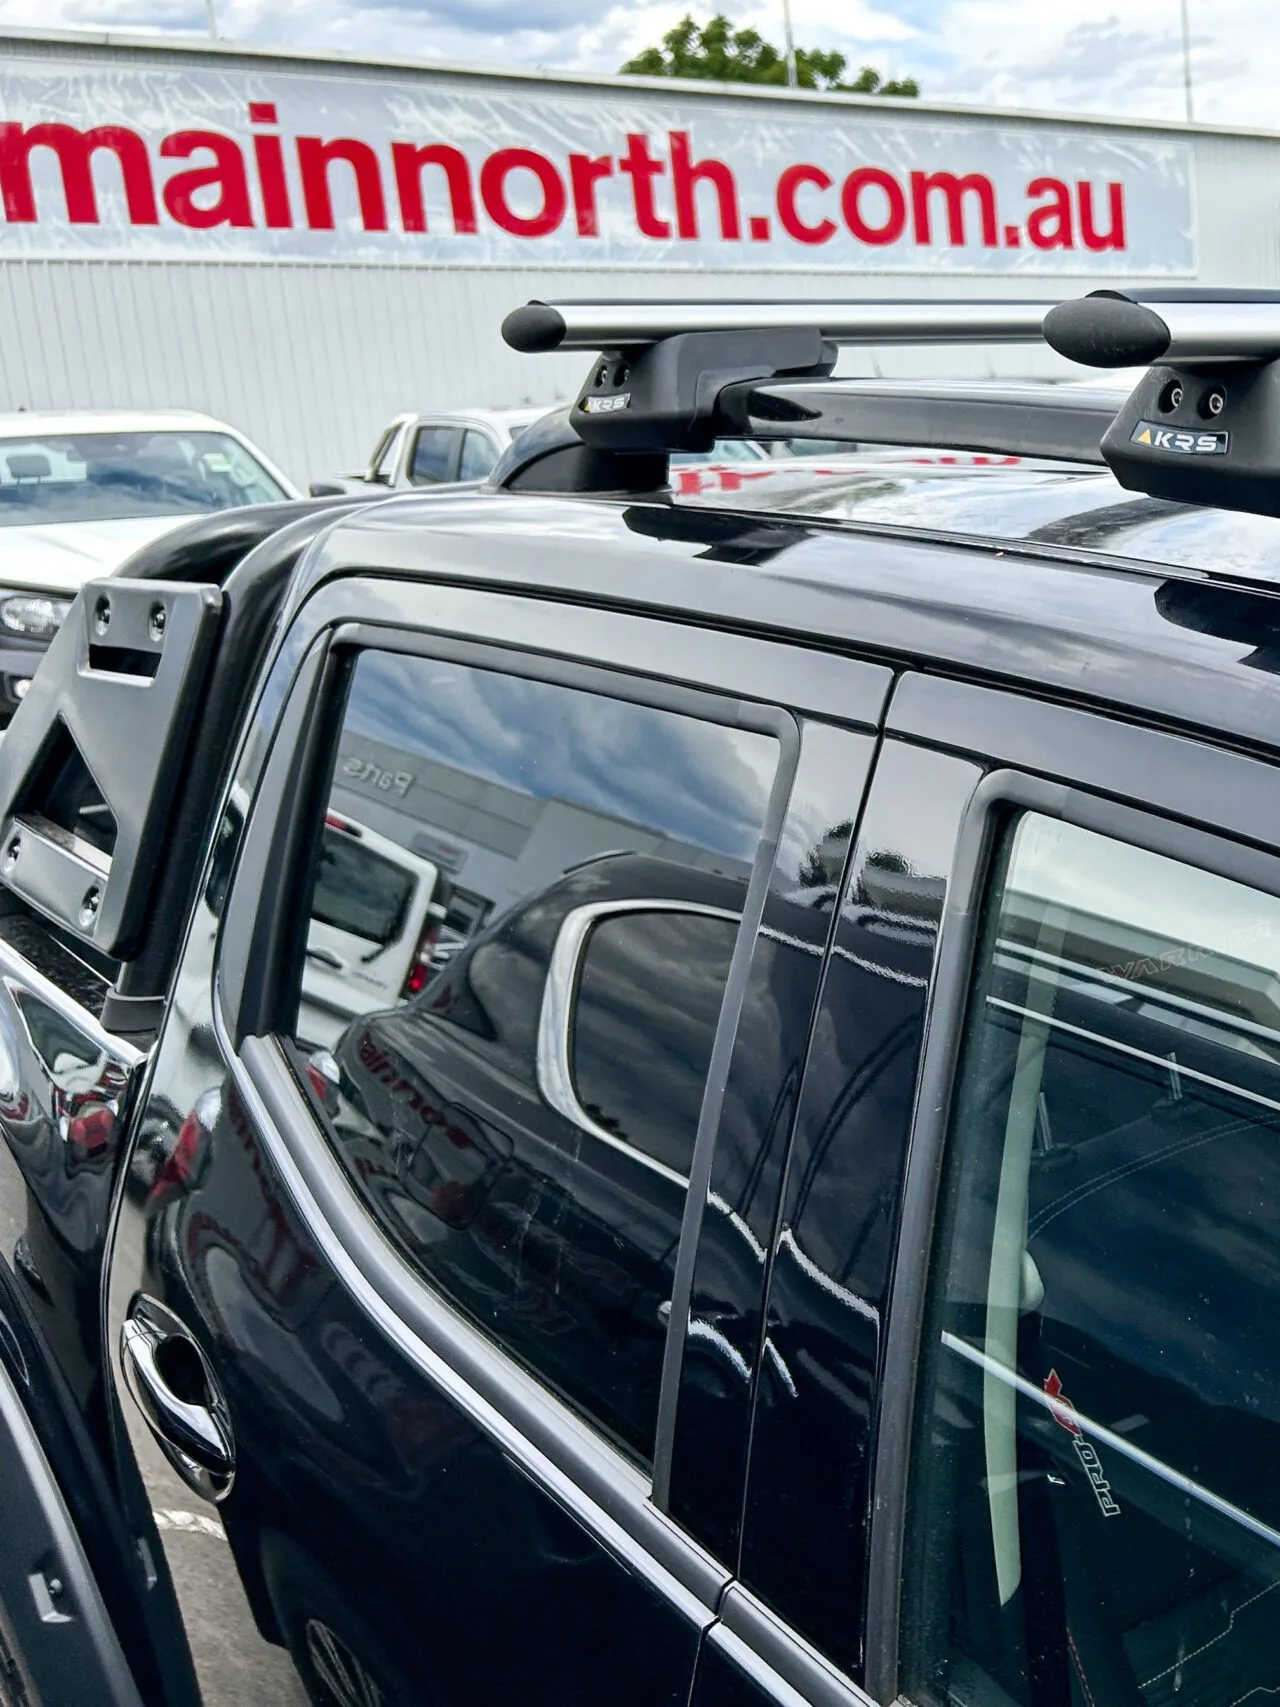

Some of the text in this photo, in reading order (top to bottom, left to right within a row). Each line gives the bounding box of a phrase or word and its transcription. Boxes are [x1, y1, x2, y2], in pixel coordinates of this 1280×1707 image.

[0, 103, 1125, 251] mainnorth.com.au
[593, 396, 626, 411] KRS
[1154, 430, 1218, 452] KRS
